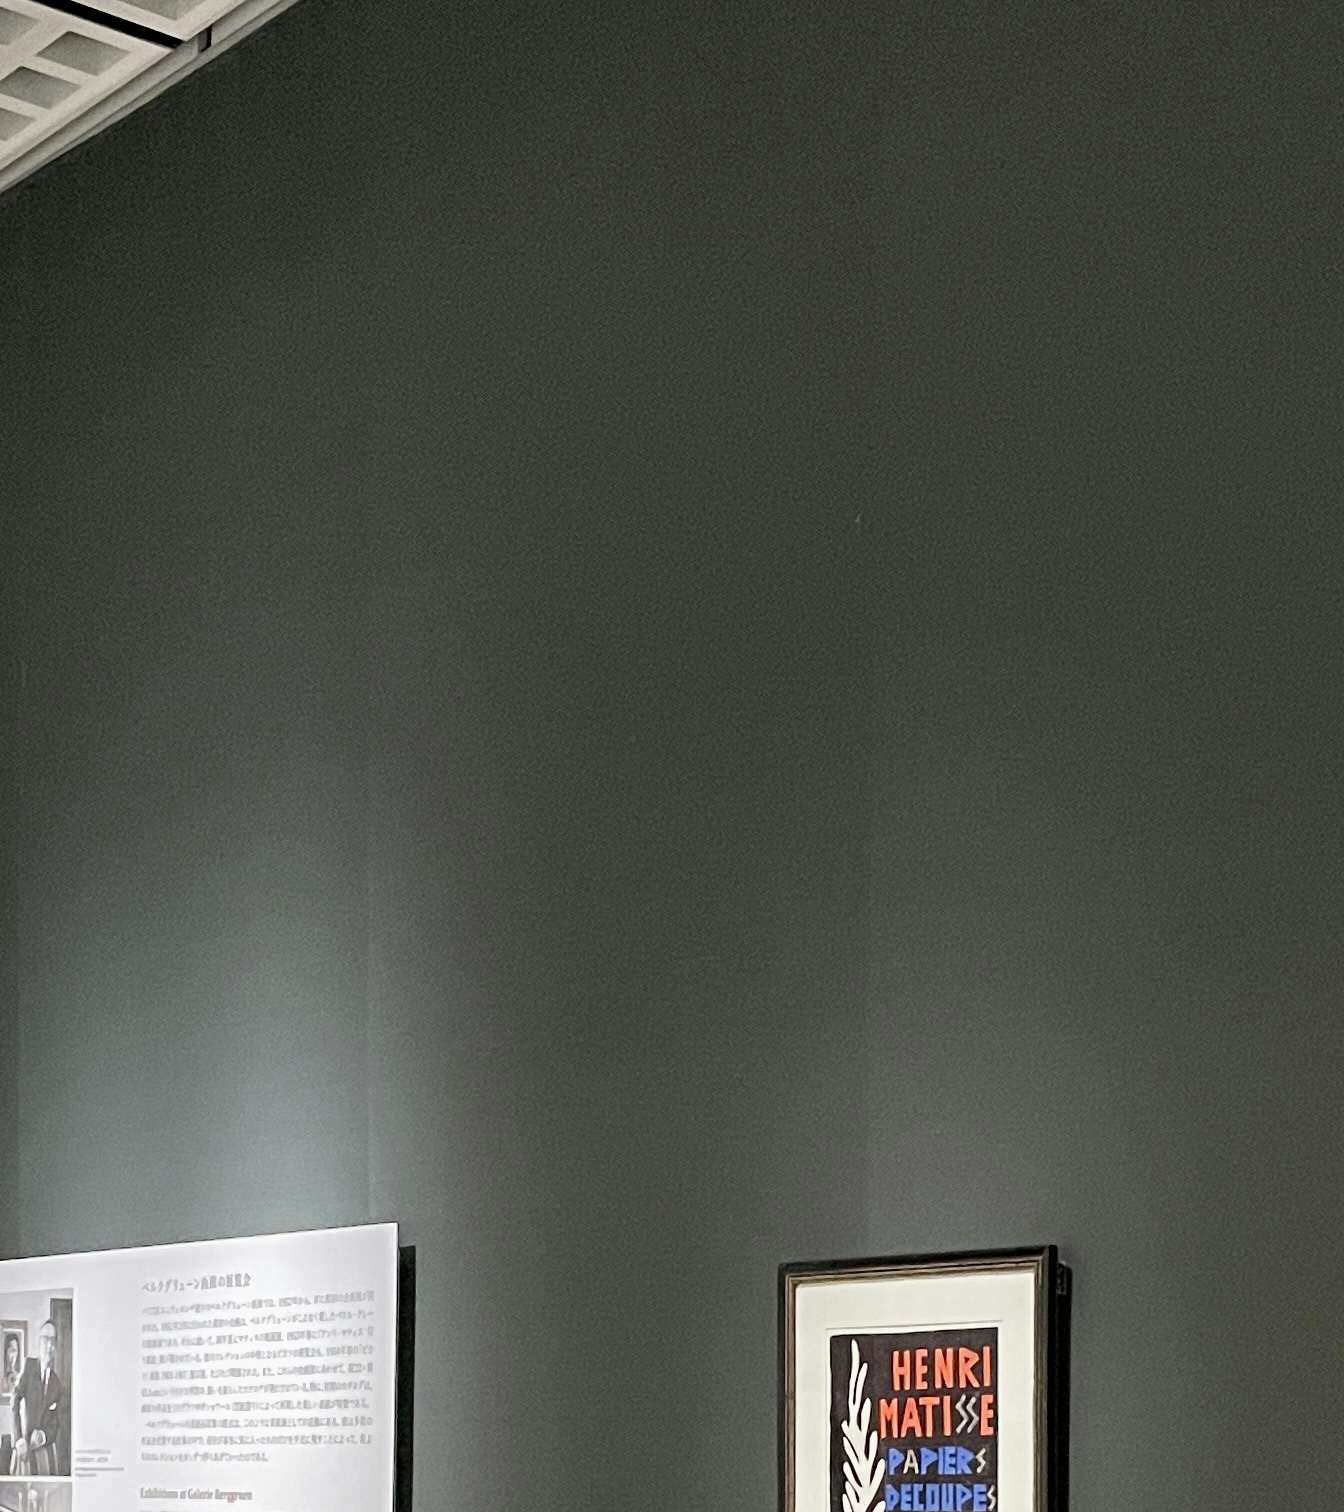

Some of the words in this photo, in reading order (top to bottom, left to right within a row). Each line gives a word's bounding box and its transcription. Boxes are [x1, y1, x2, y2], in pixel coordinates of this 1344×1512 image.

[892, 1345, 992, 1391] HENRI
[879, 1394, 994, 1439] MATISSE
[887, 1446, 987, 1475] PAPIERS
[884, 1483, 996, 1512] DECOUPES
